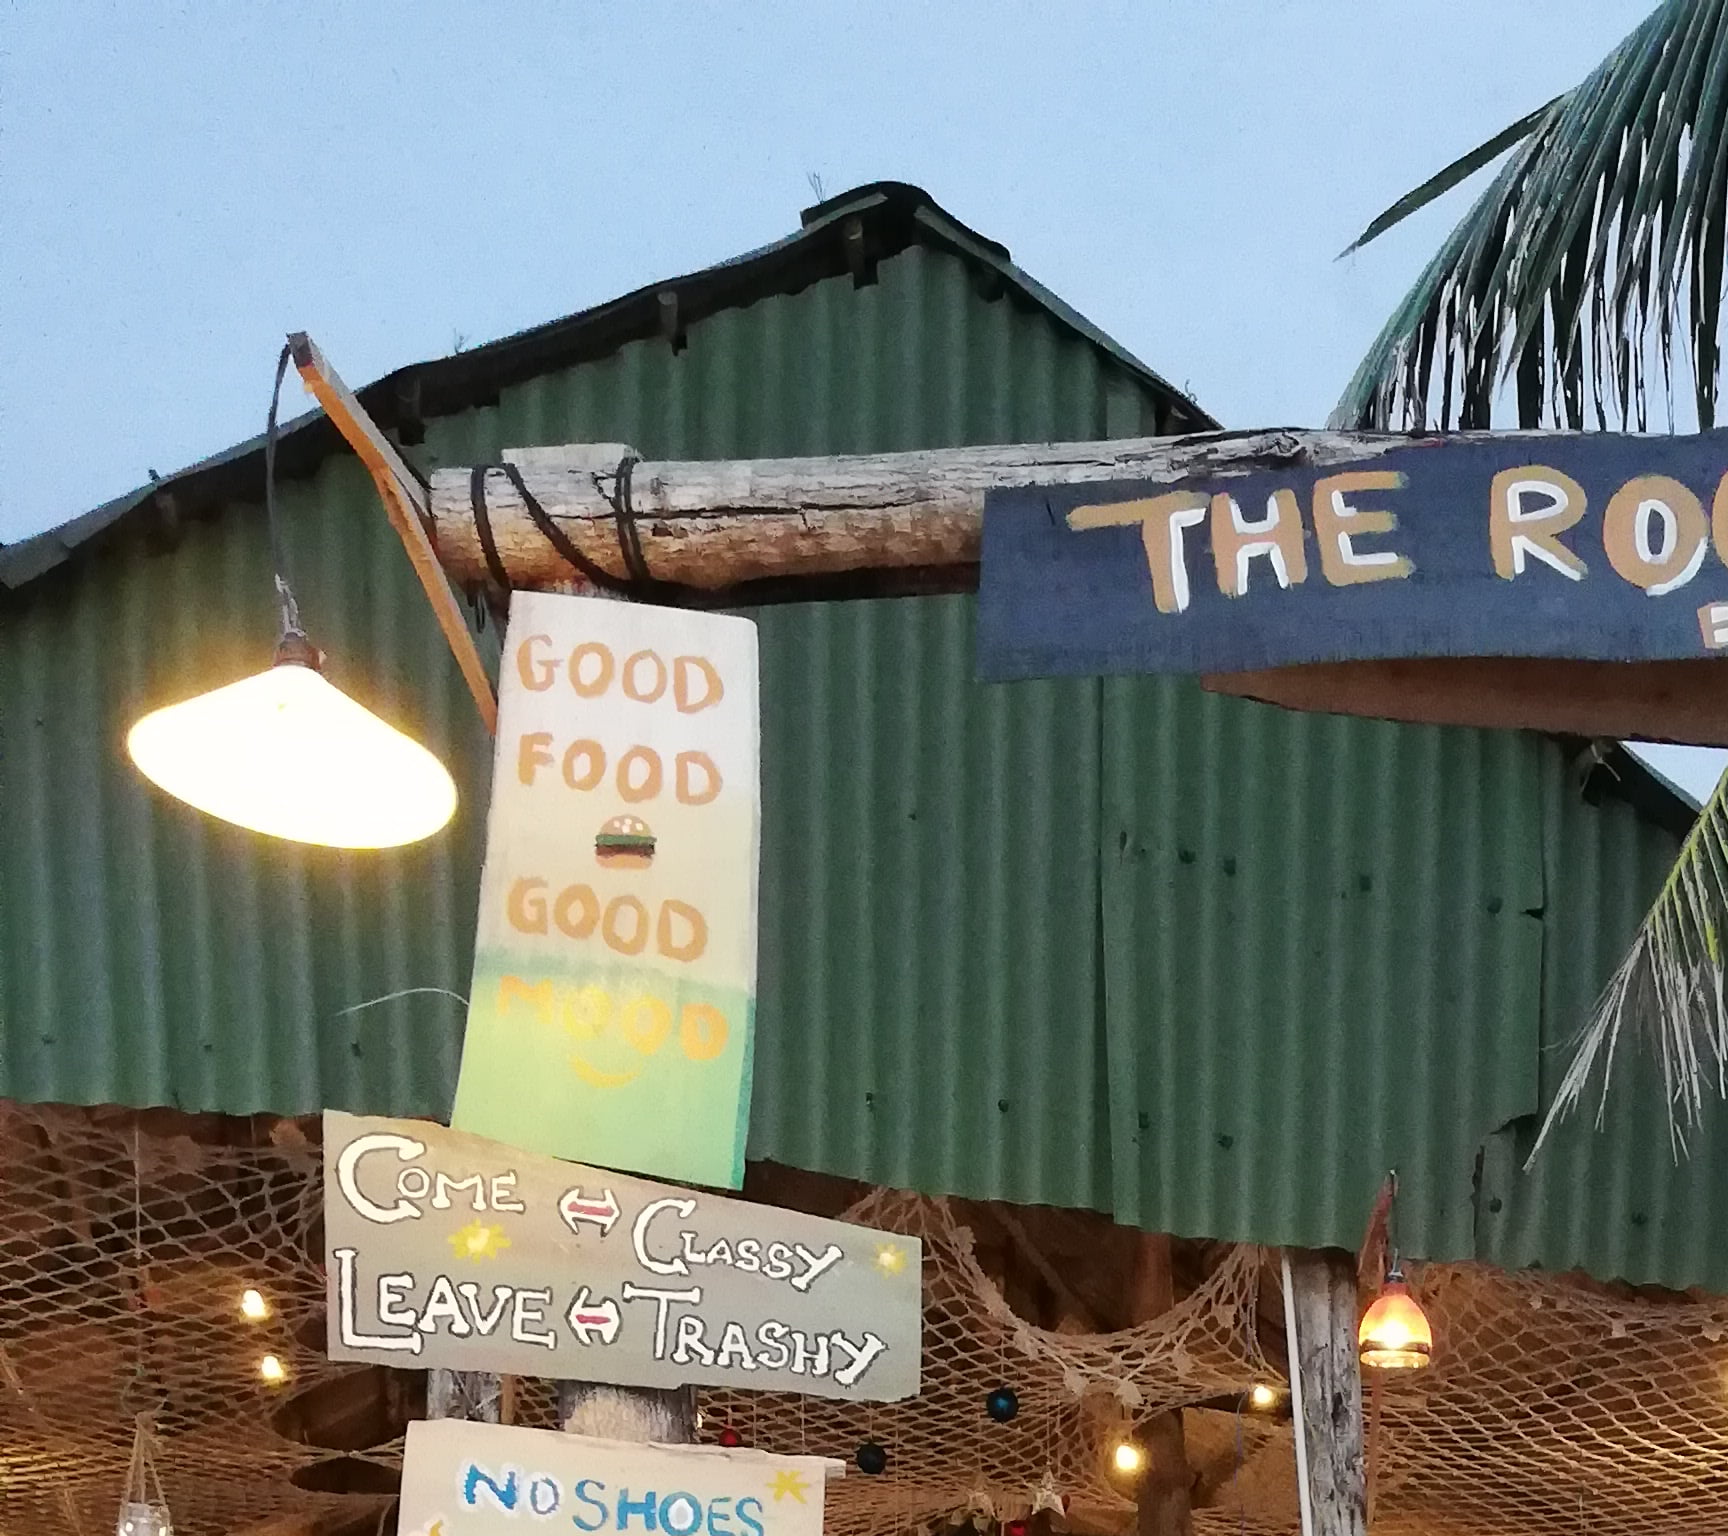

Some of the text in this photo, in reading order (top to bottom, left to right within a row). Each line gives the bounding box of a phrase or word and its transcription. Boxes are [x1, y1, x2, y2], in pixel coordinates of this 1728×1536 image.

[1068, 469, 1415, 616] THE
[516, 634, 725, 713] GOOD
[518, 732, 723, 805] FOOD
[507, 876, 709, 963] GOOD
[496, 975, 729, 1060] MOOD
[335, 1132, 845, 1292] COME CLASSY
[335, 1247, 887, 1386] LEAVE TRASHY
[462, 1463, 562, 1517] NO
